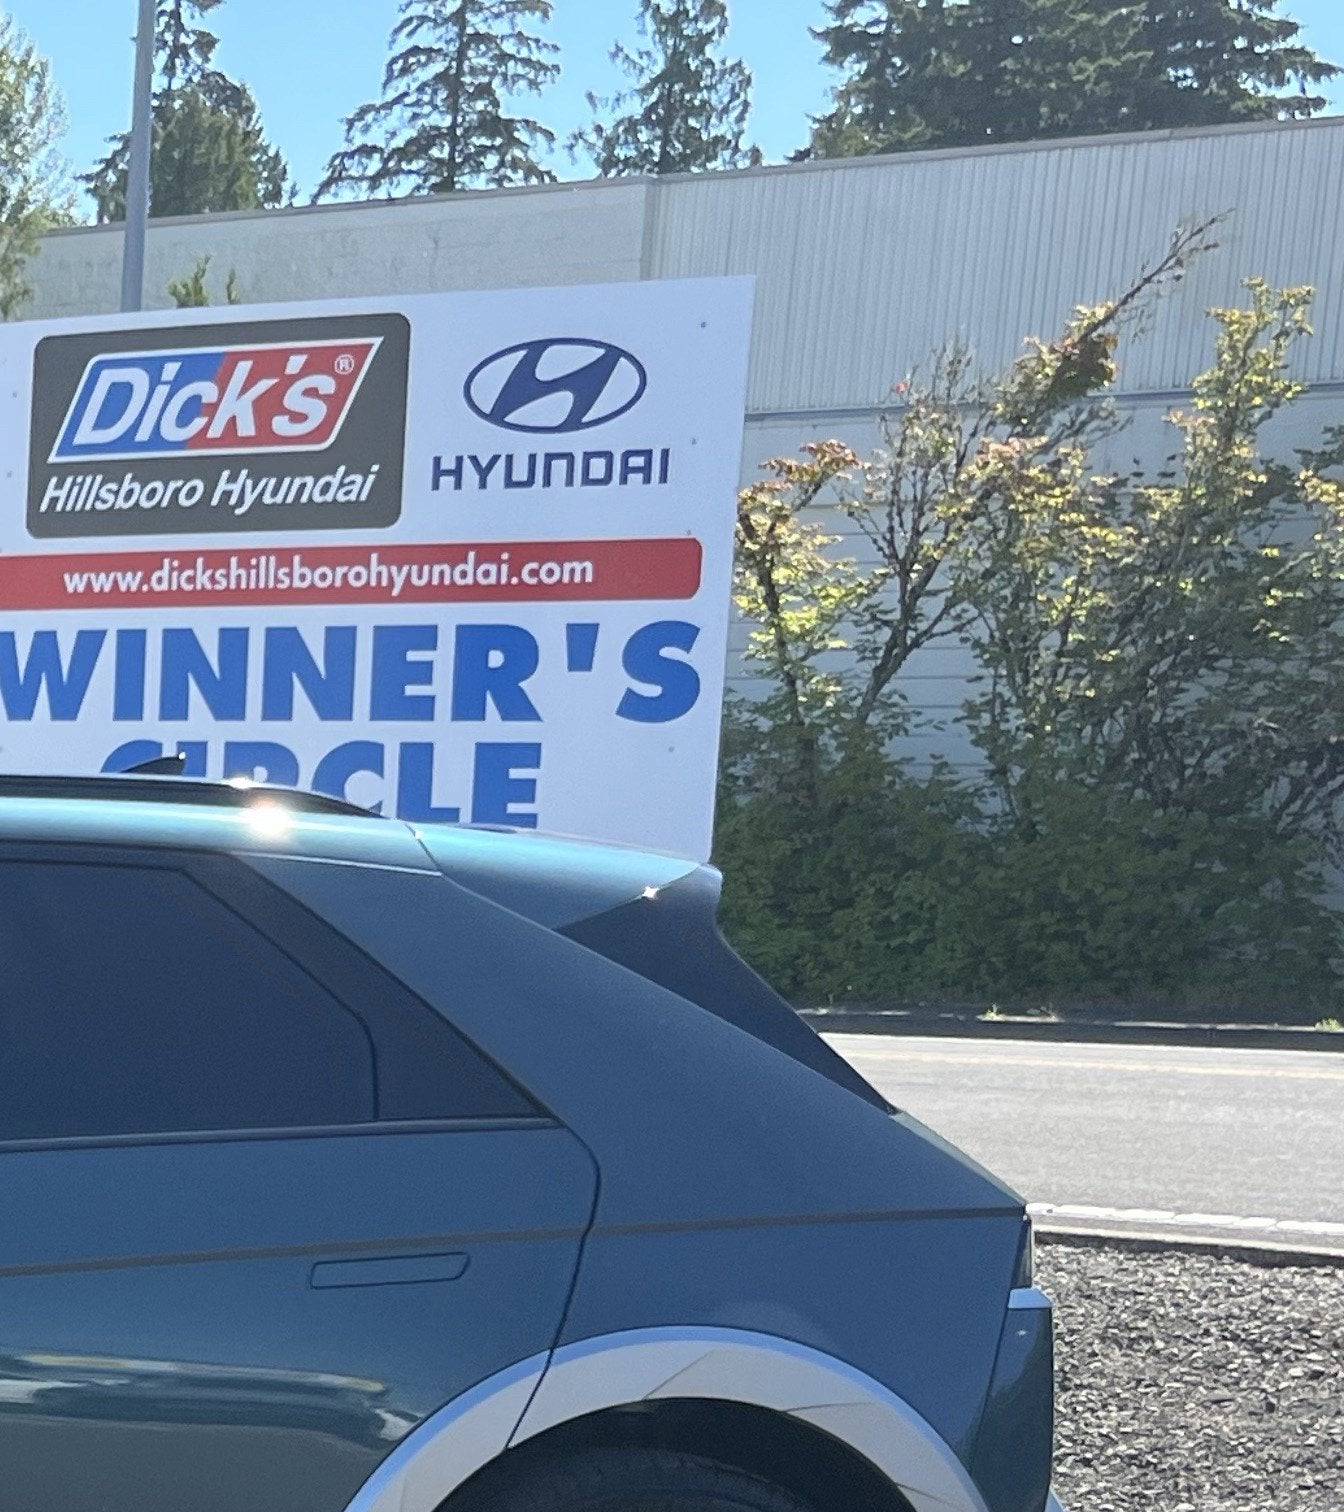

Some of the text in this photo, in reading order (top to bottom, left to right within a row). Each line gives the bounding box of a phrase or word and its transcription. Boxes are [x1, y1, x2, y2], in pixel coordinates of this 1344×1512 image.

[73, 354, 336, 446] Dick's
[39, 463, 380, 516] Hillsboro Hyundai
[430, 448, 671, 491] HYUNDAI
[62, 552, 594, 596] www.dickshillsborohyundai.com
